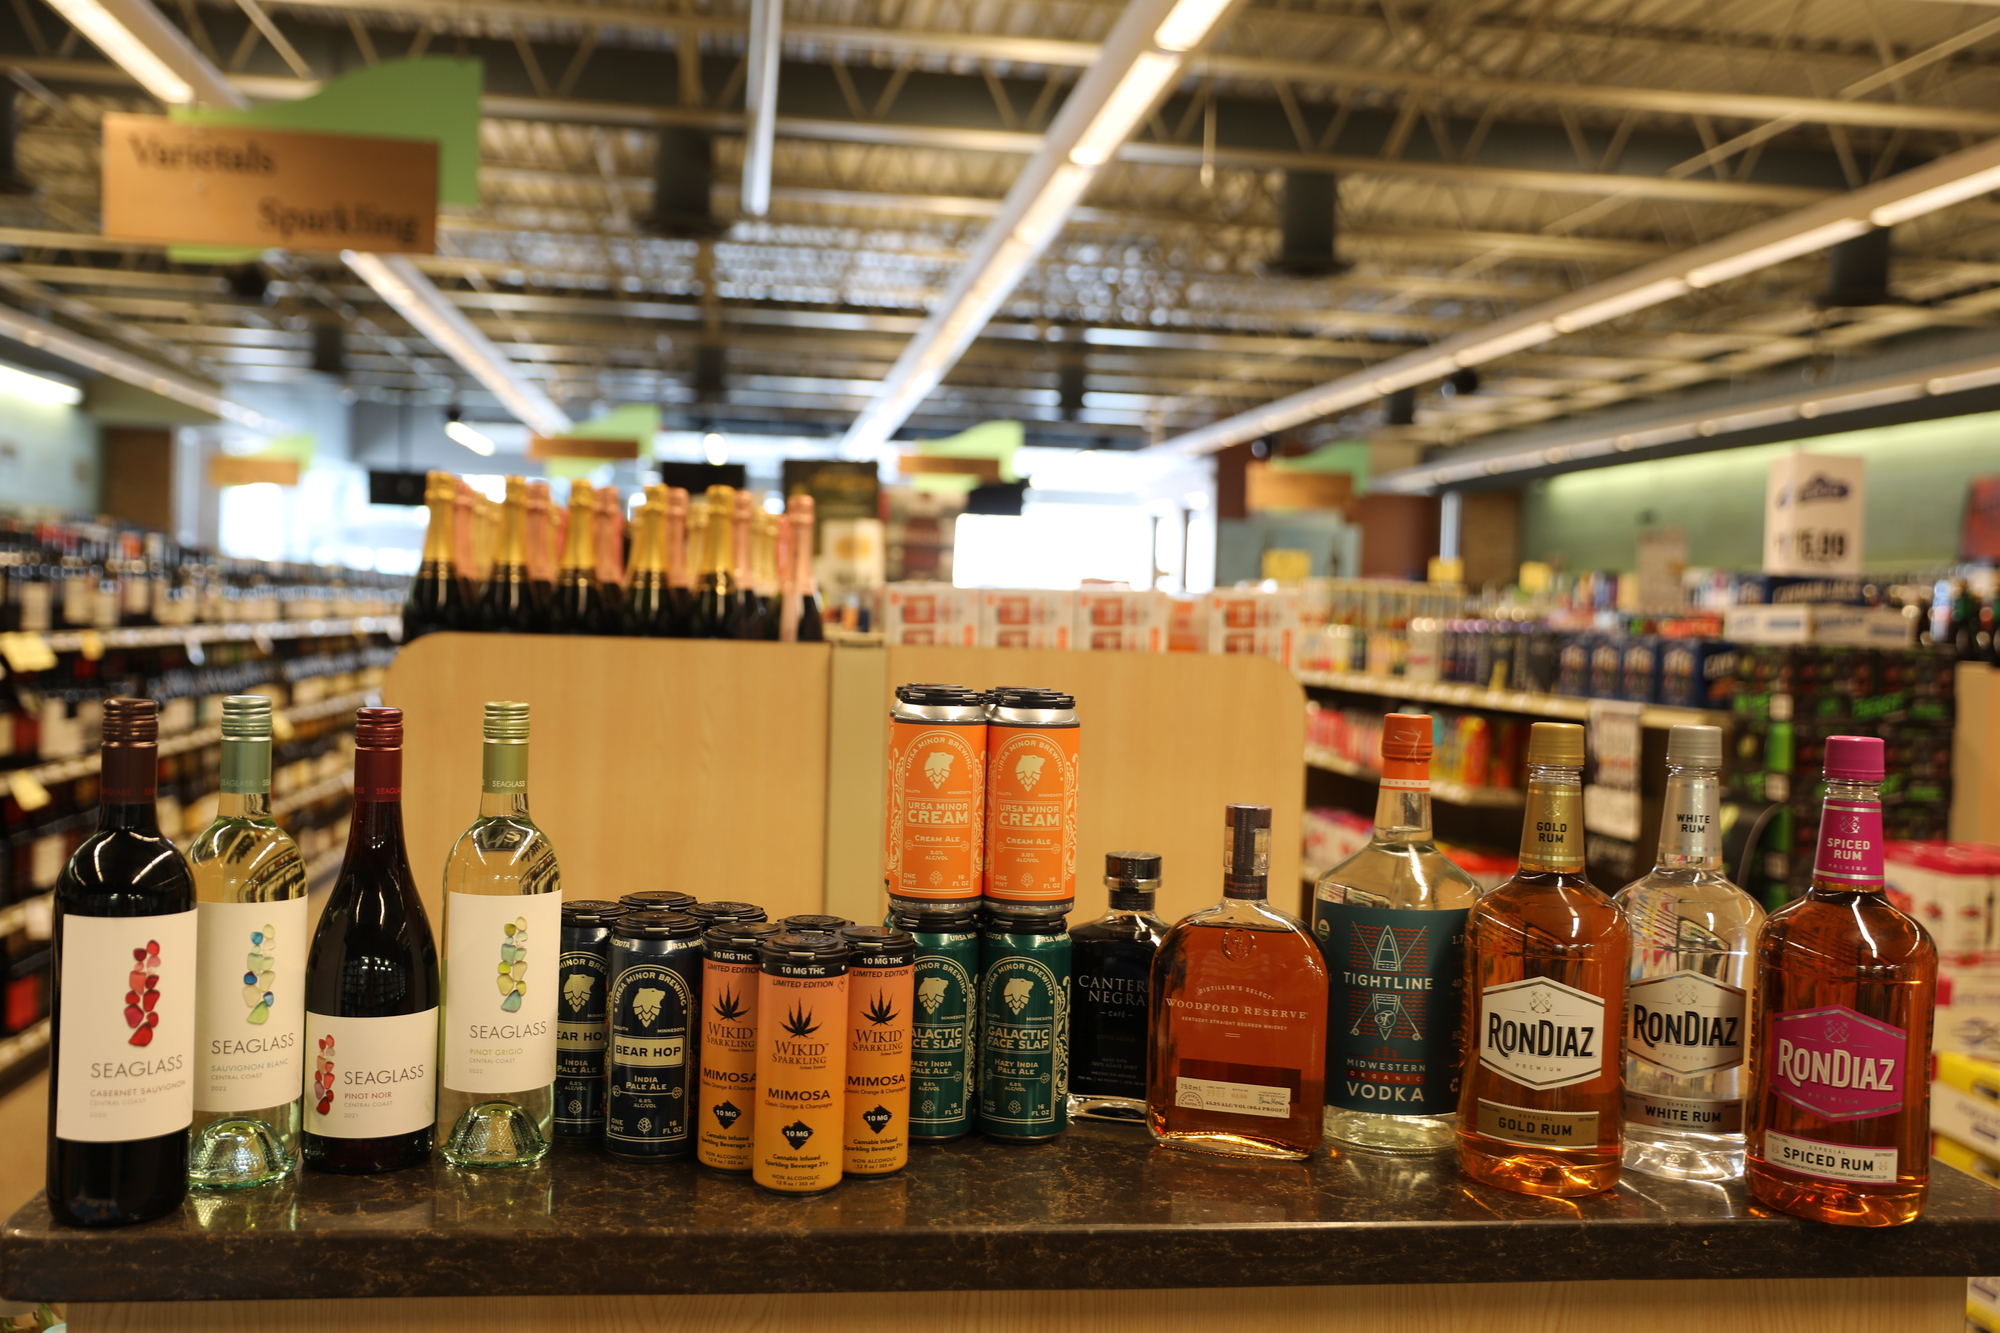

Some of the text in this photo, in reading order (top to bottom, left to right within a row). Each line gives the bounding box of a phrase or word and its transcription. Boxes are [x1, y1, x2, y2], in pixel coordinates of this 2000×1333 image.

[128, 134, 276, 175] Varietals
[257, 196, 419, 246] Sparkling
[906, 737, 973, 770] URSA MINOR BREWING
[997, 740, 1064, 774] URSA MINOR BREWING
[492, 780, 526, 788] SEAGLASS
[908, 801, 968, 811] URSA MINOR
[999, 804, 1060, 813] URSA MINOR
[907, 809, 969, 824] CREAM
[999, 811, 1060, 827] CREAM
[1676, 813, 1711, 825] WHITE
[1536, 821, 1568, 833] GOLD
[1681, 823, 1706, 835] RUM
[914, 834, 960, 843] CREAM ALE
[1005, 836, 1052, 846] CREAM ALE
[1538, 832, 1564, 844] RUM
[1826, 837, 1871, 851] SPICED
[1834, 849, 1863, 862] RUM
[713, 950, 753, 961] 10 MG THC
[862, 956, 903, 965] 10 MG THC
[707, 962, 730, 973] LIMITED
[792, 967, 807, 975] MG
[808, 967, 826, 975] THC
[852, 969, 909, 978] LIMITED EDITION
[772, 979, 834, 988] LIMITED EDITION
[942, 964, 967, 994] BREWING
[997, 963, 1054, 996] MINOR BREWING
[1078, 975, 1149, 993] CANTER
[1343, 971, 1433, 990] TIGHTLINE
[614, 971, 687, 1006] URSA MINOR BREWING
[1198, 985, 1271, 1000] DISTILLER'S SELECT
[1088, 990, 1146, 1007] NEGRA
[1108, 1010, 1125, 1018] CAFÉ
[1166, 998, 1306, 1019] WOODFORD RESERVE
[469, 1020, 547, 1039] SEAGLASS
[708, 1021, 754, 1040] WIKID
[855, 1028, 903, 1043] WIKID
[988, 1026, 1049, 1040] GALACTIC
[211, 1033, 294, 1055] SEAGLASS
[706, 1034, 755, 1048] SPARKLING
[852, 1041, 903, 1052] SPARKLING
[933, 1038, 962, 1049] SLAP
[987, 1036, 1049, 1049] FACE SLAP
[469, 1048, 523, 1056] PINOT GRIGIO
[615, 1044, 681, 1057] BEAR HOP
[774, 1040, 825, 1056] WIKID
[565, 1058, 588, 1066] INDIA
[772, 1053, 827, 1065] SPARKLING
[1662, 1052, 1708, 1061] PREMIUM
[90, 1054, 183, 1079] SEAGLASS
[211, 1058, 289, 1073] SAUVIGNON BLANC
[557, 1065, 577, 1073] PALE
[994, 1059, 1039, 1068] HAZY INDIA
[1346, 1058, 1426, 1072] MIDWESTERN
[1515, 1062, 1562, 1072] PREMIUM
[343, 1064, 424, 1085] SEAGLASS
[703, 1067, 756, 1083] MIMOSA
[997, 1066, 1017, 1074] PALE
[1349, 1070, 1421, 1082] ORGANIC
[634, 1075, 658, 1083] INDIA
[847, 1074, 906, 1087] MIMOSA
[89, 1079, 186, 1098] CABERNET SAUVIGNON
[625, 1081, 647, 1090] PALE
[1346, 1081, 1425, 1102] VODKA
[344, 1091, 392, 1100] PINOT NOIR
[768, 1087, 831, 1101] MIMOSA
[1808, 1092, 1859, 1105] PREMIUM
[89, 1097, 147, 1107] CENTRAL COAST
[779, 1102, 833, 1110] Orange Champagne
[1220, 1102, 1246, 1110] ALC/VOL
[724, 1110, 737, 1118] MG
[1645, 1105, 1722, 1123] WHITE RUM
[1498, 1117, 1572, 1136] GOLD RUM
[720, 1141, 746, 1150] Beverage
[844, 1144, 895, 1153] Sparkling Beverage
[772, 1153, 798, 1161] Cannabis
[868, 1156, 897, 1164] ALCOHOLIC
[1783, 1146, 1874, 1172] SPICED RUM
[765, 1159, 789, 1169] Sparkling
